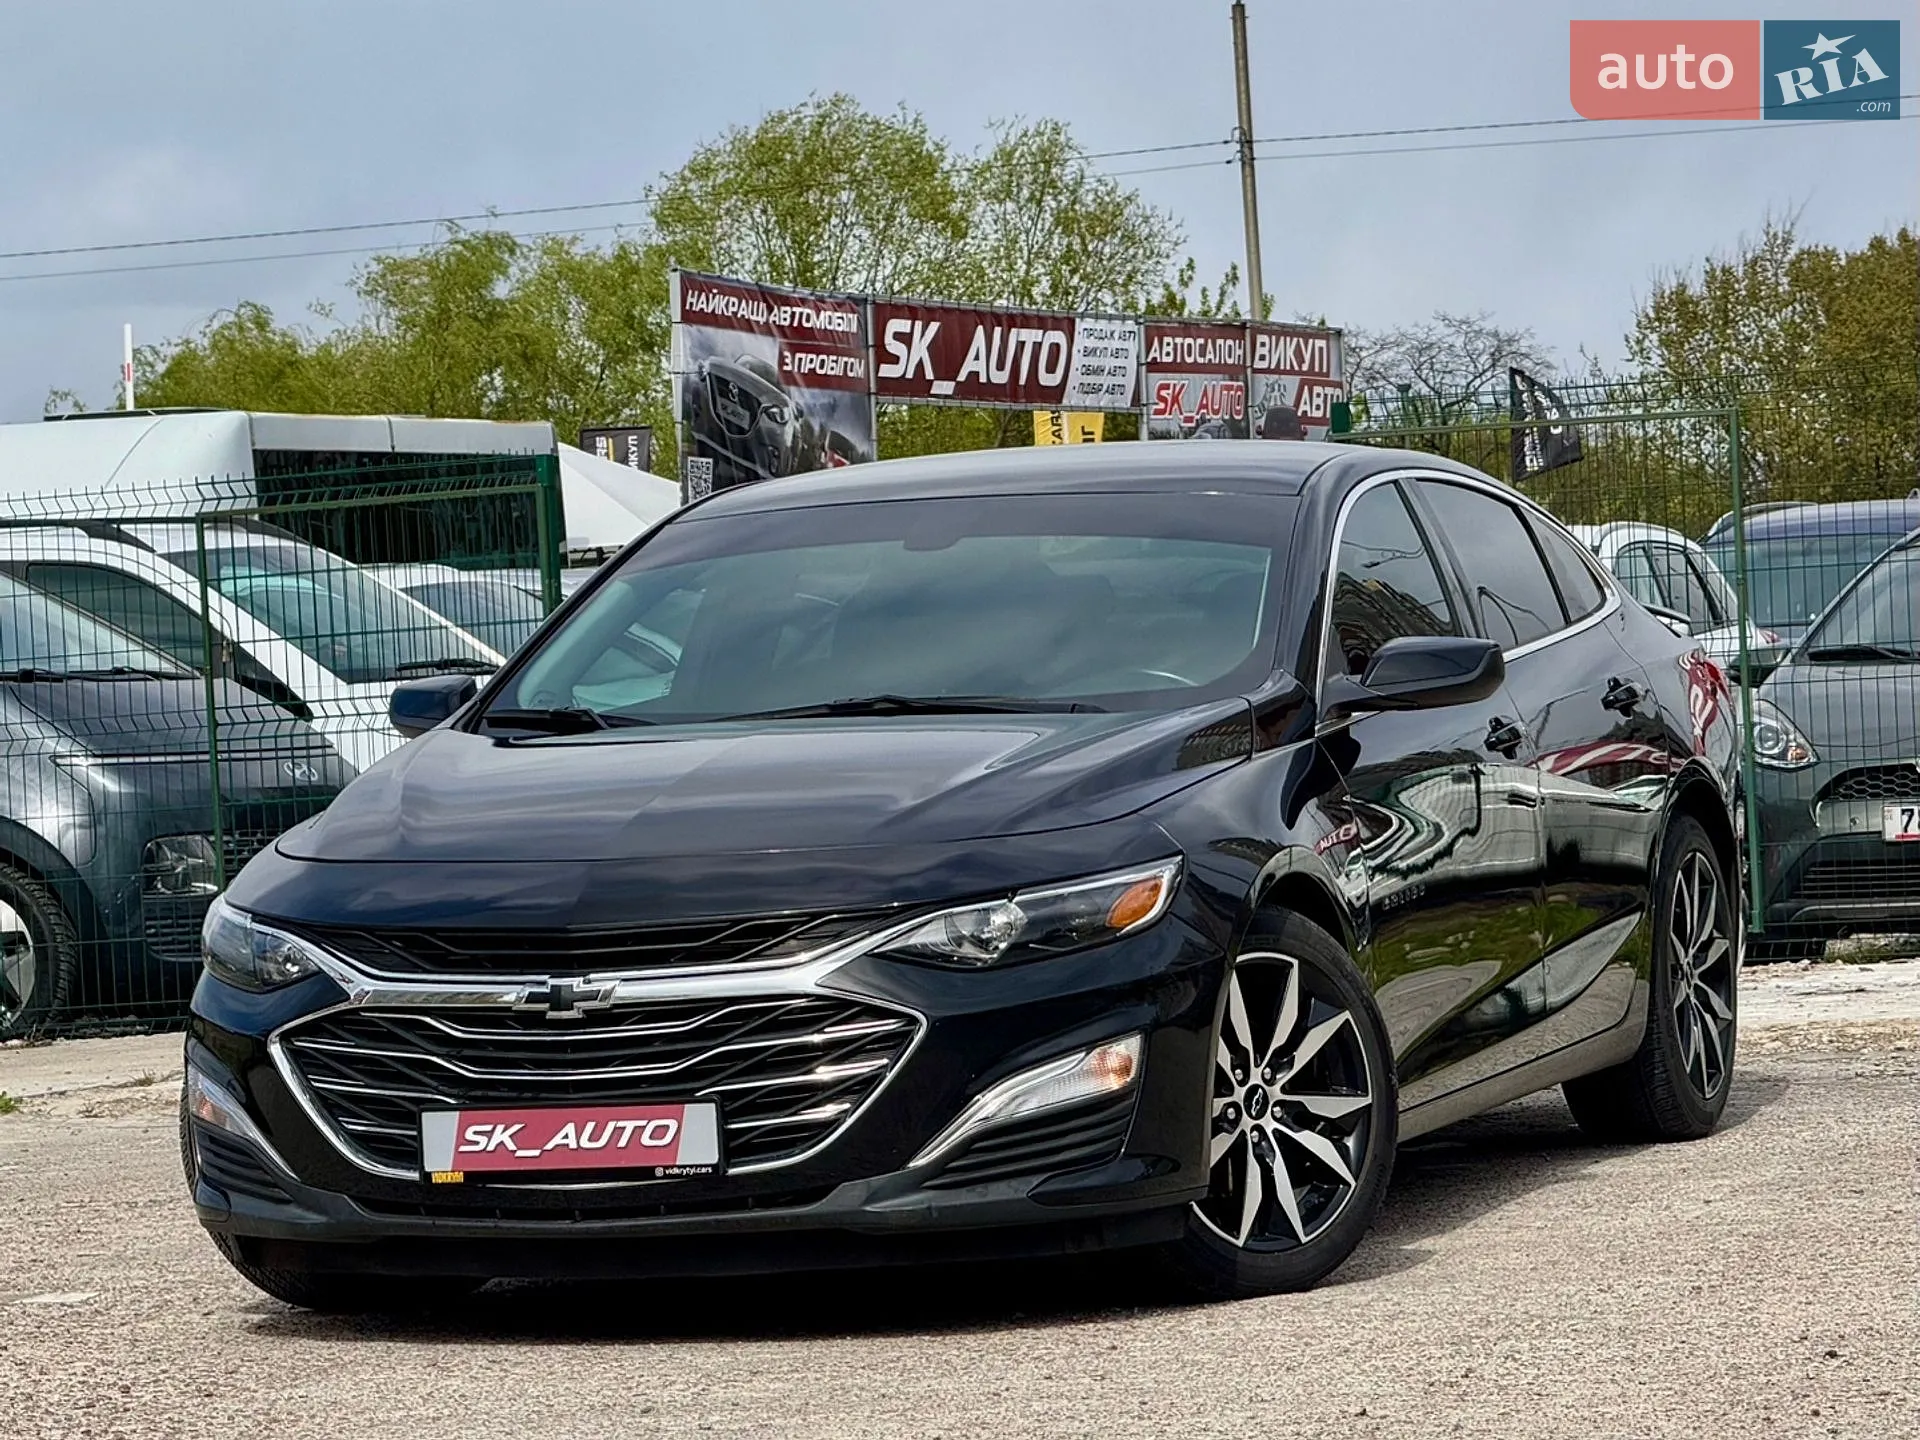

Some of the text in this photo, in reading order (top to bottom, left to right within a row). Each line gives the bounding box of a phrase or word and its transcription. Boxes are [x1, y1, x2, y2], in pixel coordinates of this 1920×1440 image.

[768, 305, 859, 334] АВТОМОБІЛІ
[781, 351, 865, 379] З ПРОБІГОМ
[877, 318, 1068, 395] SK_AUTO
[1110, 347, 1129, 360] АВТО
[1147, 336, 1244, 366] АВТОСАЛОН
[1253, 334, 1328, 373] ВИКУП
[1106, 365, 1128, 378] АВТО
[1104, 383, 1126, 396] АВТО
[1150, 380, 1246, 427] SK_AUTO
[458, 1118, 680, 1158] SK_AUTO
